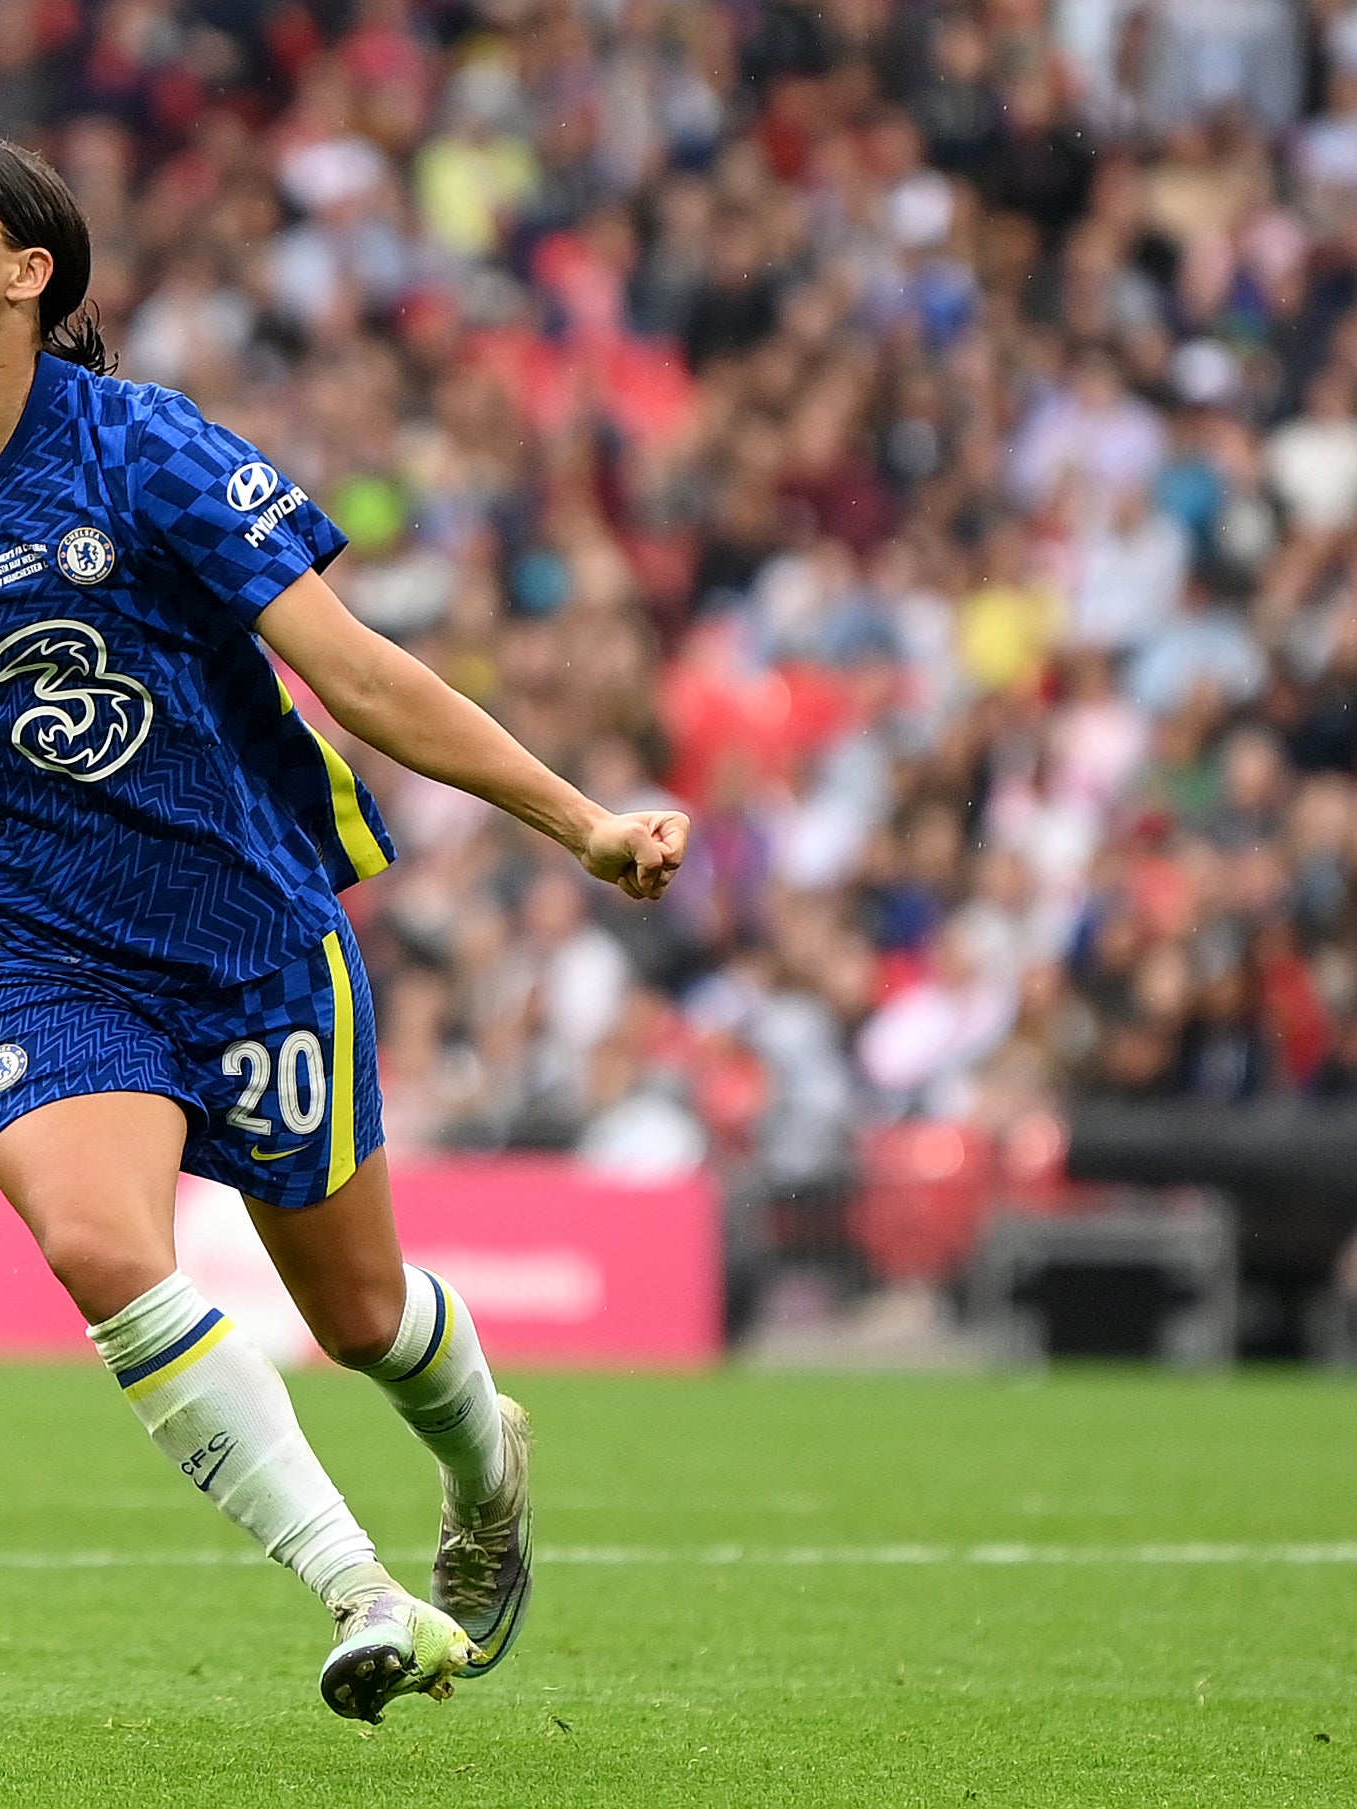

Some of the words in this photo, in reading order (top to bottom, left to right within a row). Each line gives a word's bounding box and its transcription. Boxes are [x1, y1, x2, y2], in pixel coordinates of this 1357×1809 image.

[64, 529, 100, 546] CHELSEA
[244, 486, 309, 548] HYUNDA
[2, 562, 43, 585] MANCHESTER
[222, 1030, 326, 1136] 20
[181, 1430, 230, 1475] CFC
